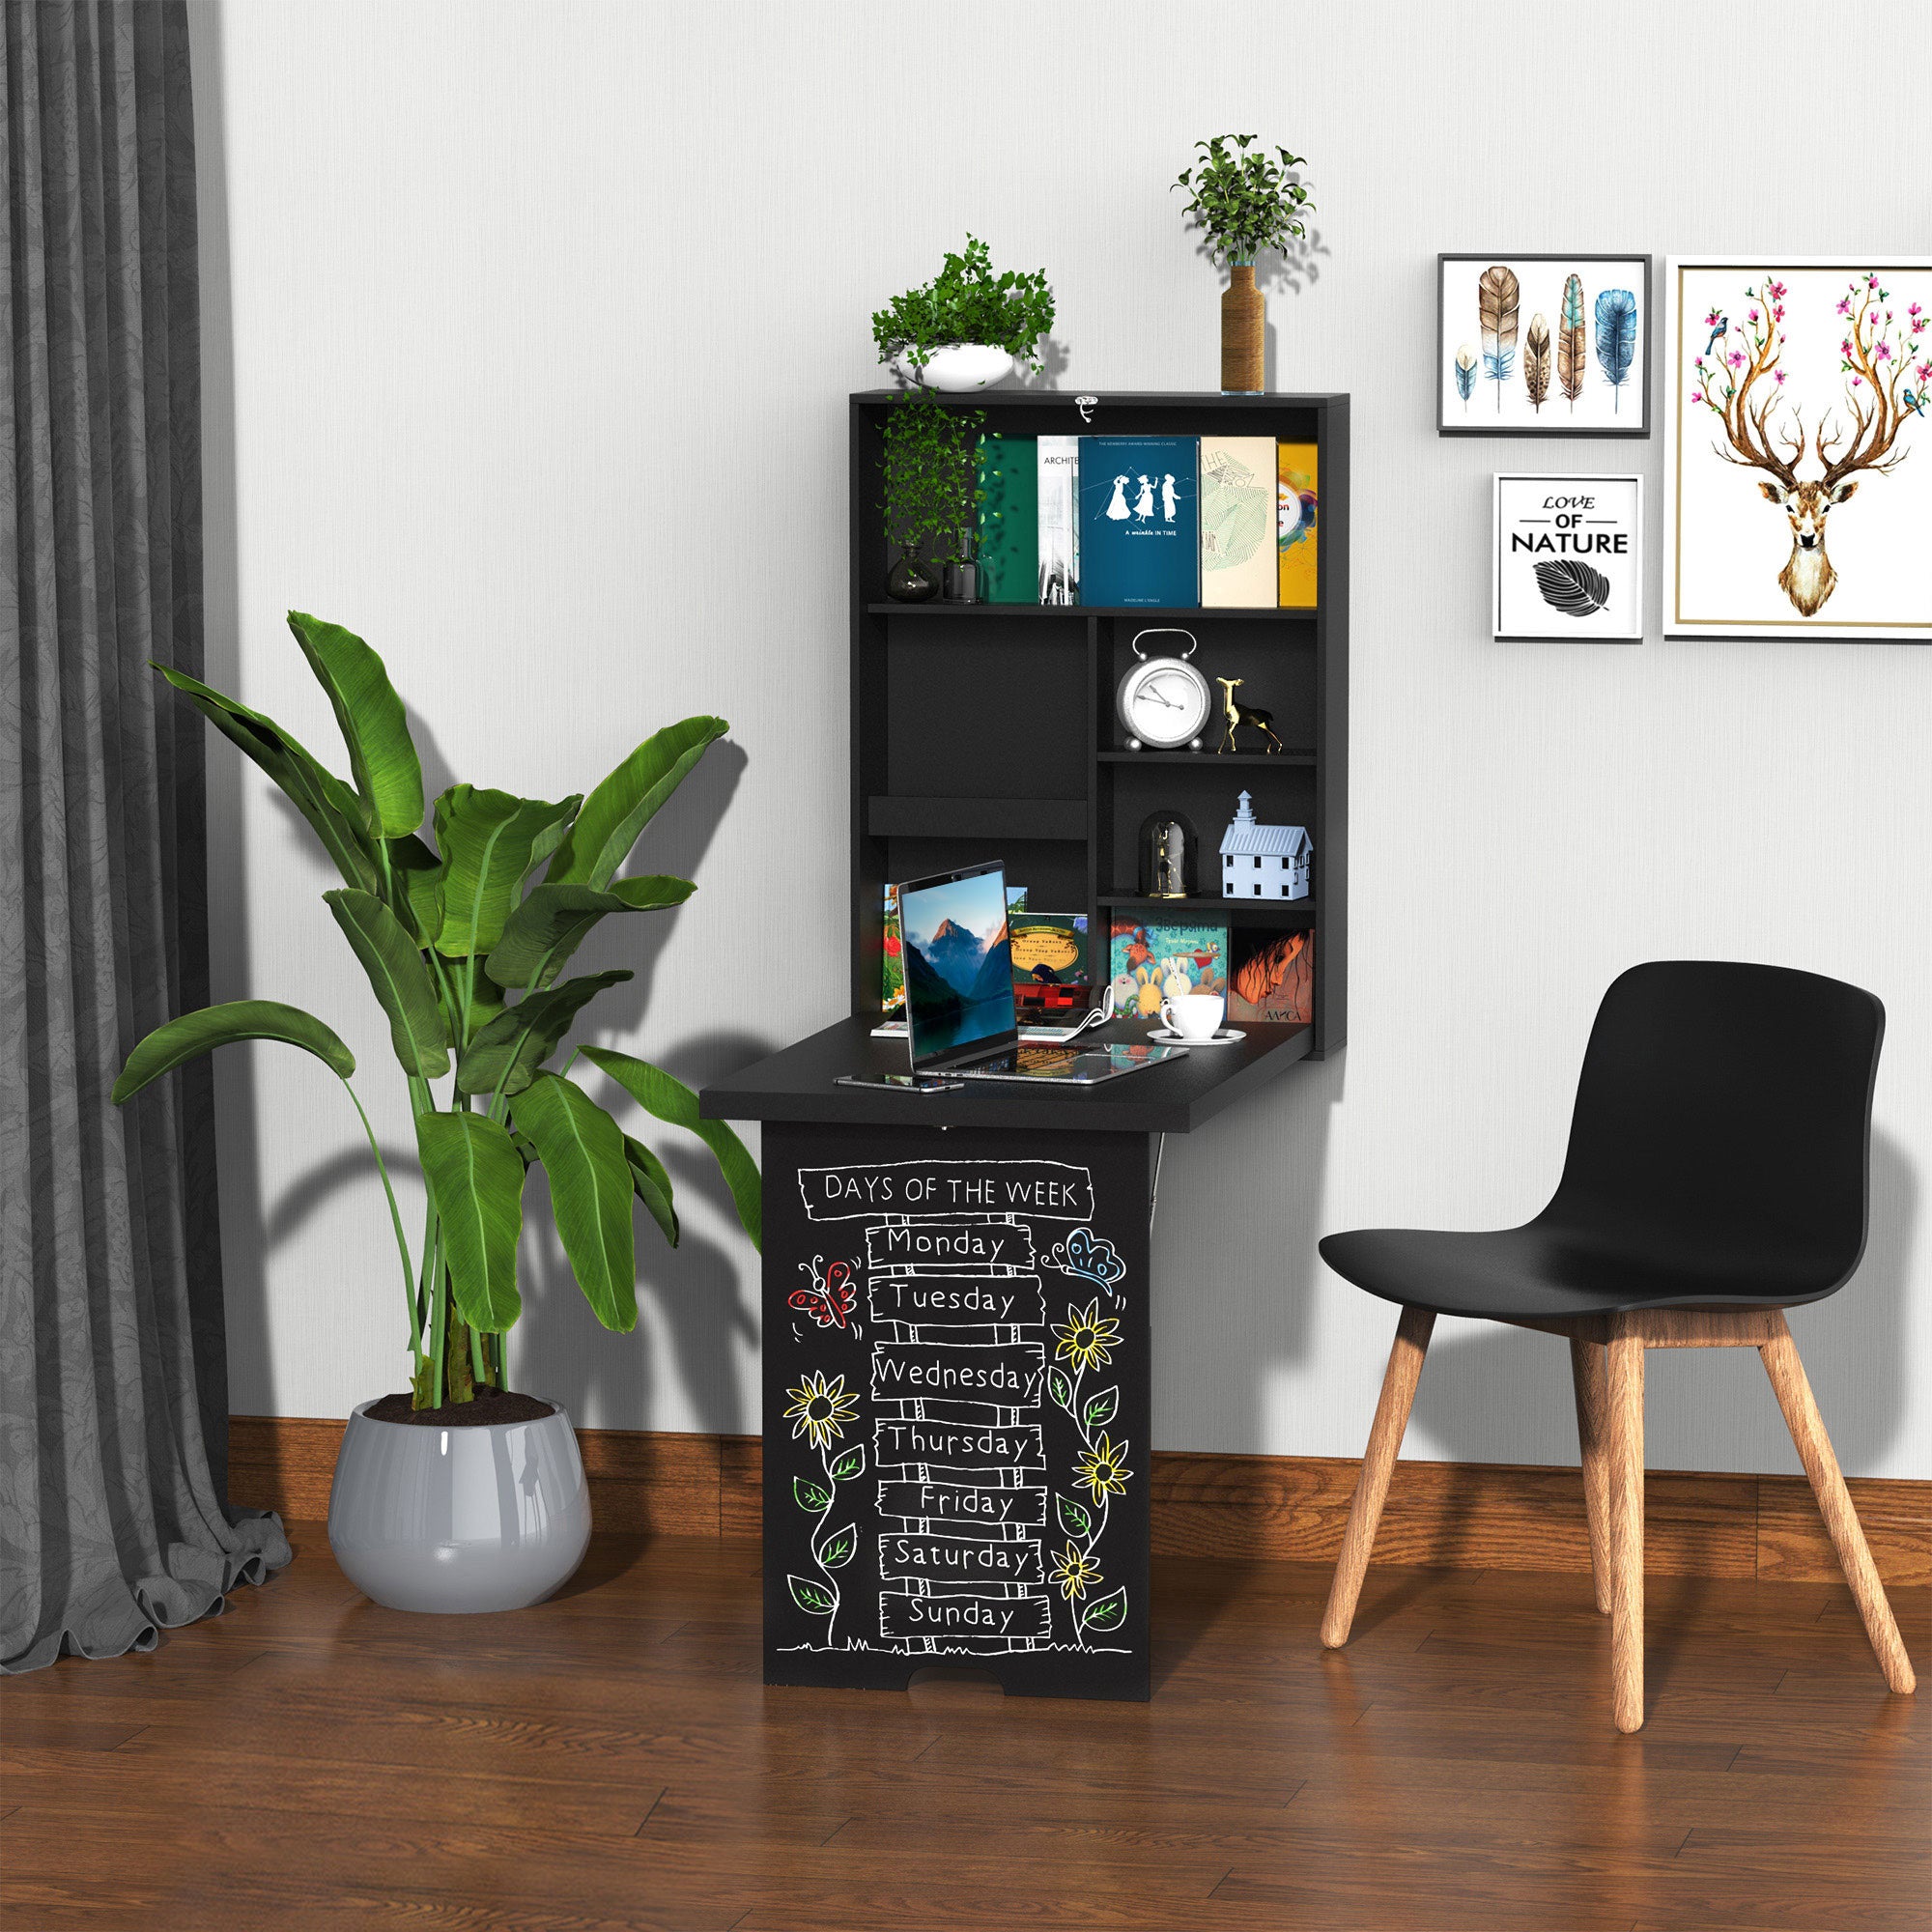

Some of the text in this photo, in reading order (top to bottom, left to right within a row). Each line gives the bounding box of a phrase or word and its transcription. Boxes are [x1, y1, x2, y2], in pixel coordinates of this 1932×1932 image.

[1542, 496, 1595, 510] LOVE
[1555, 514, 1583, 528] OF
[1512, 532, 1628, 554] NATURE
[1265, 1010, 1301, 1021] АЛИСА
[825, 1174, 1078, 1208] DAYS OF THE WEEK
[888, 1228, 1005, 1263] Monday
[888, 1283, 1015, 1320] Tuesday
[875, 1357, 1037, 1396] Wednesday
[888, 1426, 1029, 1462] Thursday
[921, 1486, 1014, 1517] Friday
[895, 1540, 1030, 1577] Saturday
[908, 1599, 1015, 1634] Sunday
